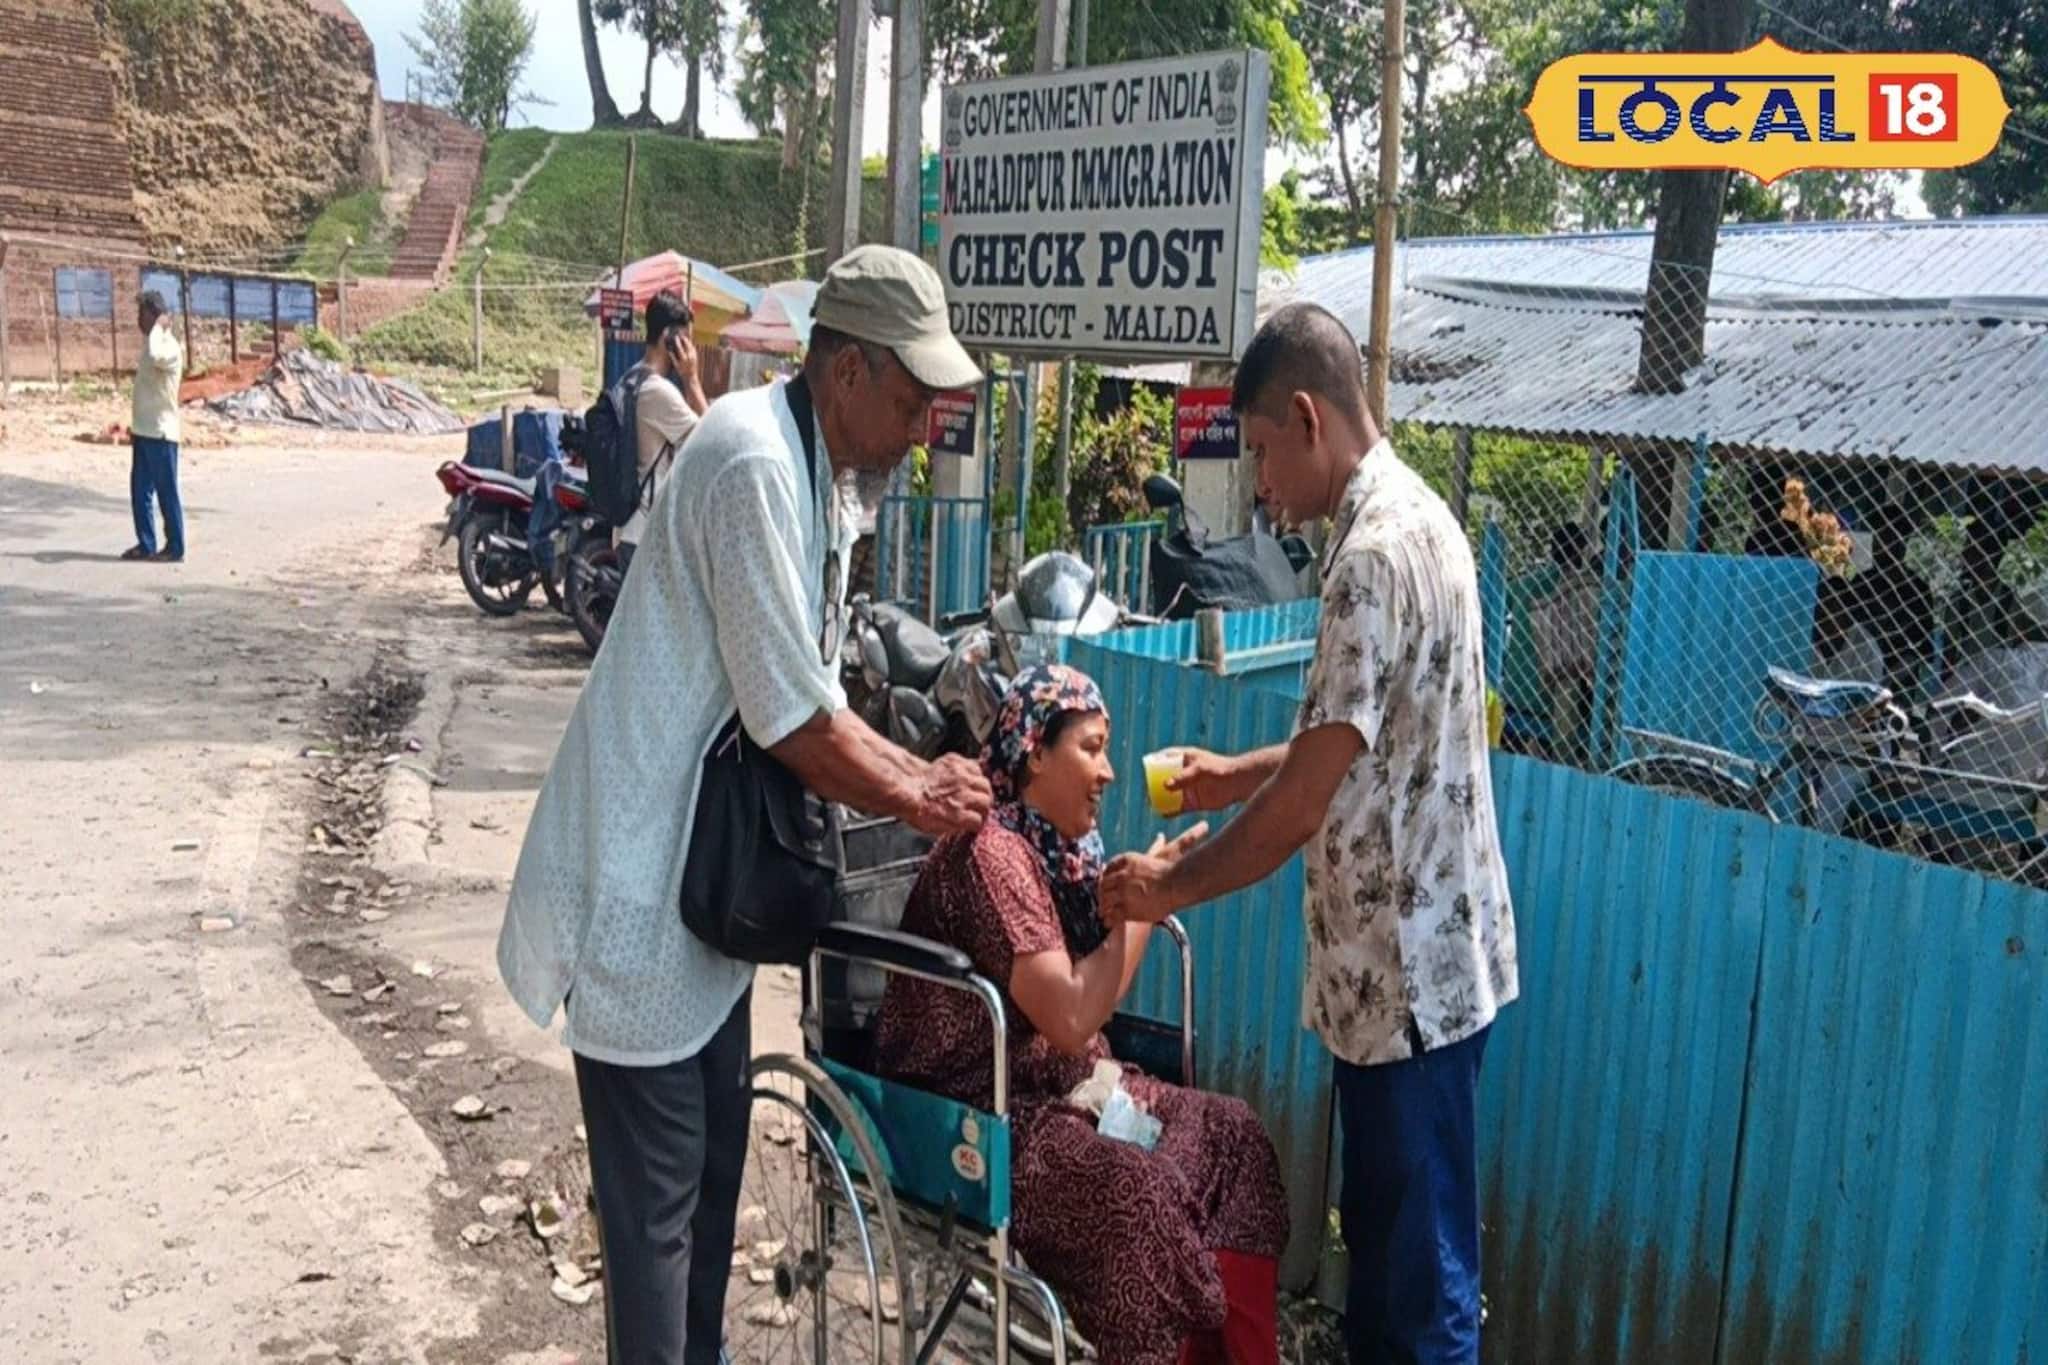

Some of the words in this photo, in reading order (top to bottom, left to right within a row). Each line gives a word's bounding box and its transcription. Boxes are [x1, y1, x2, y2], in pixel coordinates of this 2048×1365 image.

[964, 81, 1107, 136] GOVERNMENT
[1112, 78, 1144, 125] OF
[1148, 70, 1214, 122] INDIA
[944, 149, 1066, 216] MAHADIPUR
[1070, 137, 1236, 210] IMMIGRATION
[949, 231, 1086, 288] CHECK
[1097, 228, 1224, 289] POST
[949, 302, 1076, 339] DISTRICT
[1103, 305, 1221, 345] MALDA
